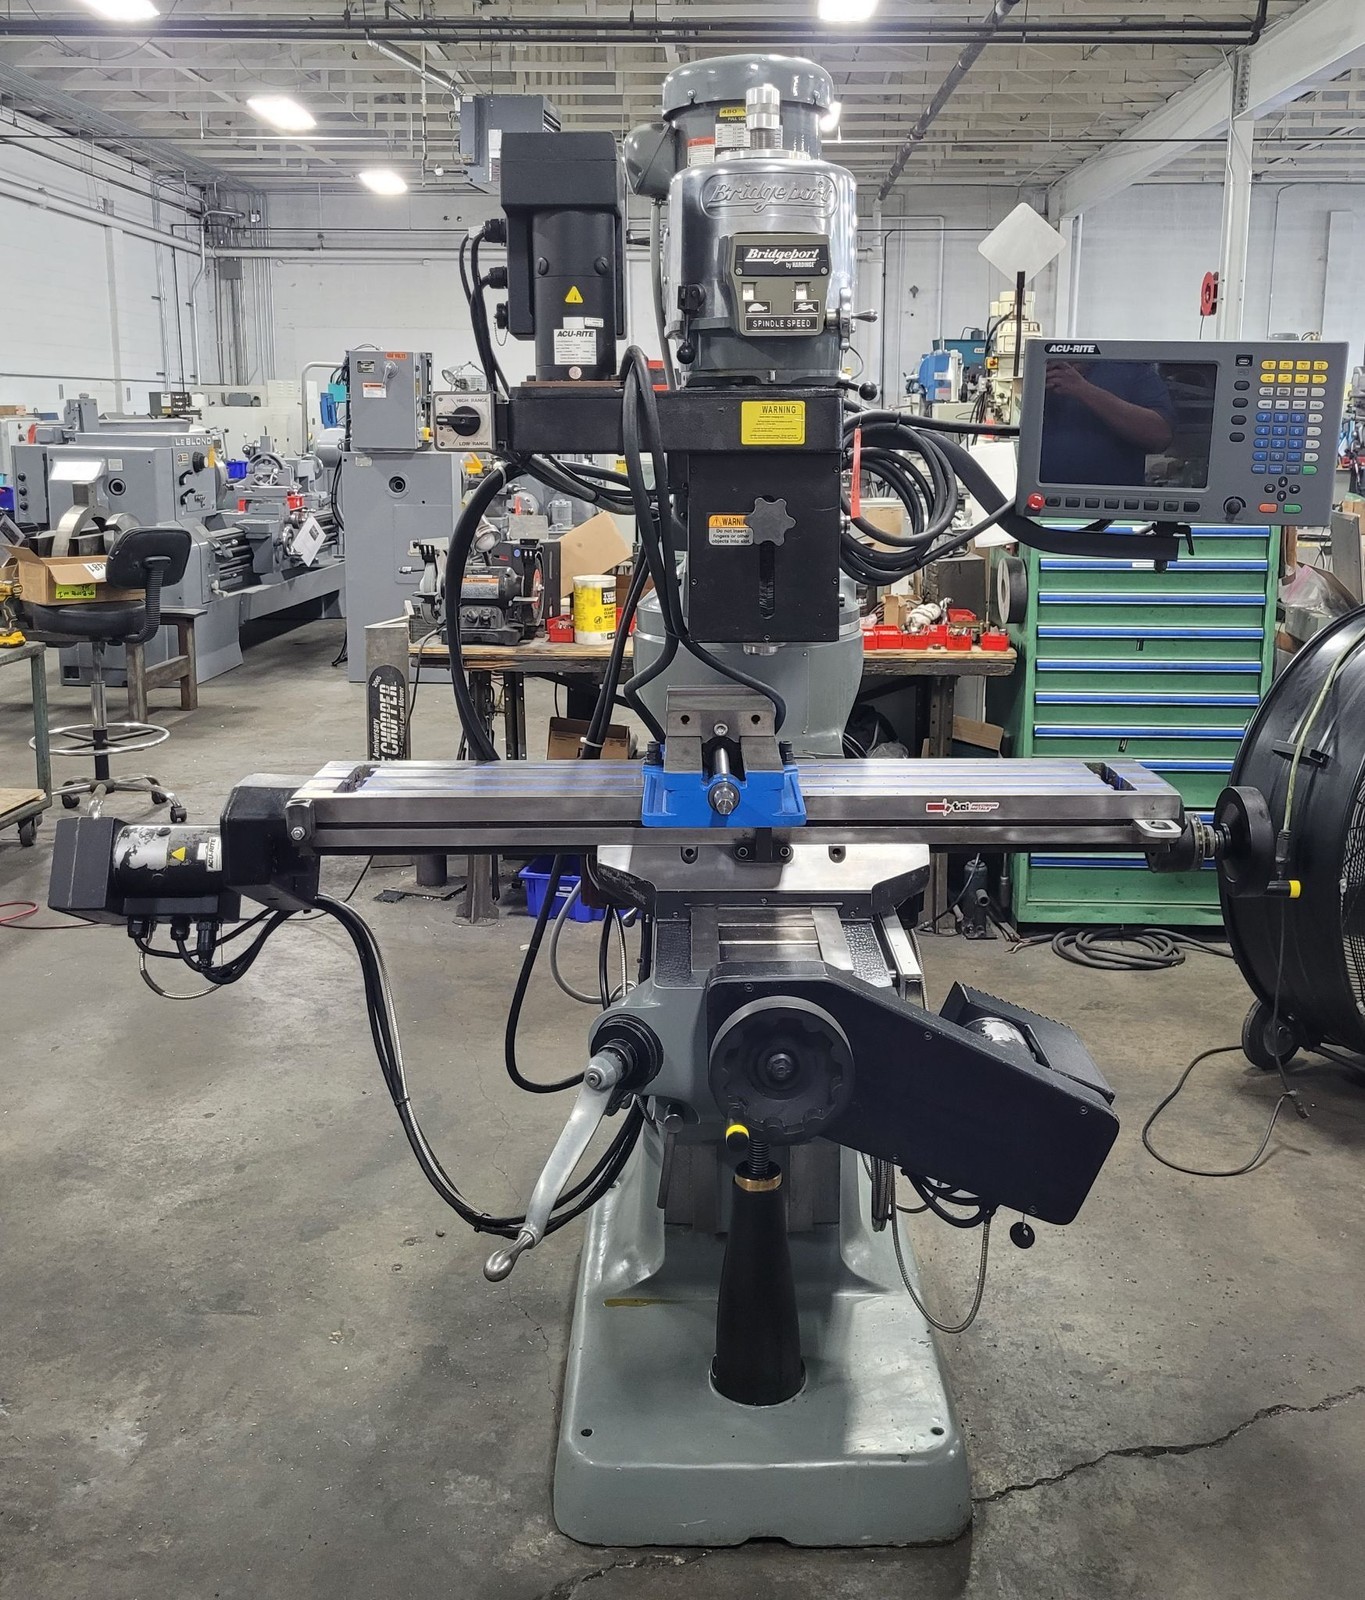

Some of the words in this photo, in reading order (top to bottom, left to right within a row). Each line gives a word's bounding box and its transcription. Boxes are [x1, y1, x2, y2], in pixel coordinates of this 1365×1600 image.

[710, 180, 833, 213] Bridgeport
[746, 248, 820, 265] Bridgeport
[752, 320, 785, 328] SPINDLE
[786, 320, 811, 328] SPEED
[557, 330, 594, 338] ACU-RITE
[1049, 344, 1096, 353] ACU-RITE
[761, 405, 797, 414] WARNING
[722, 517, 746, 526] WARNI
[379, 684, 399, 755] CHOPPER
[372, 718, 380, 759] Anniversary
[208, 838, 216, 869] ACU-RITE
